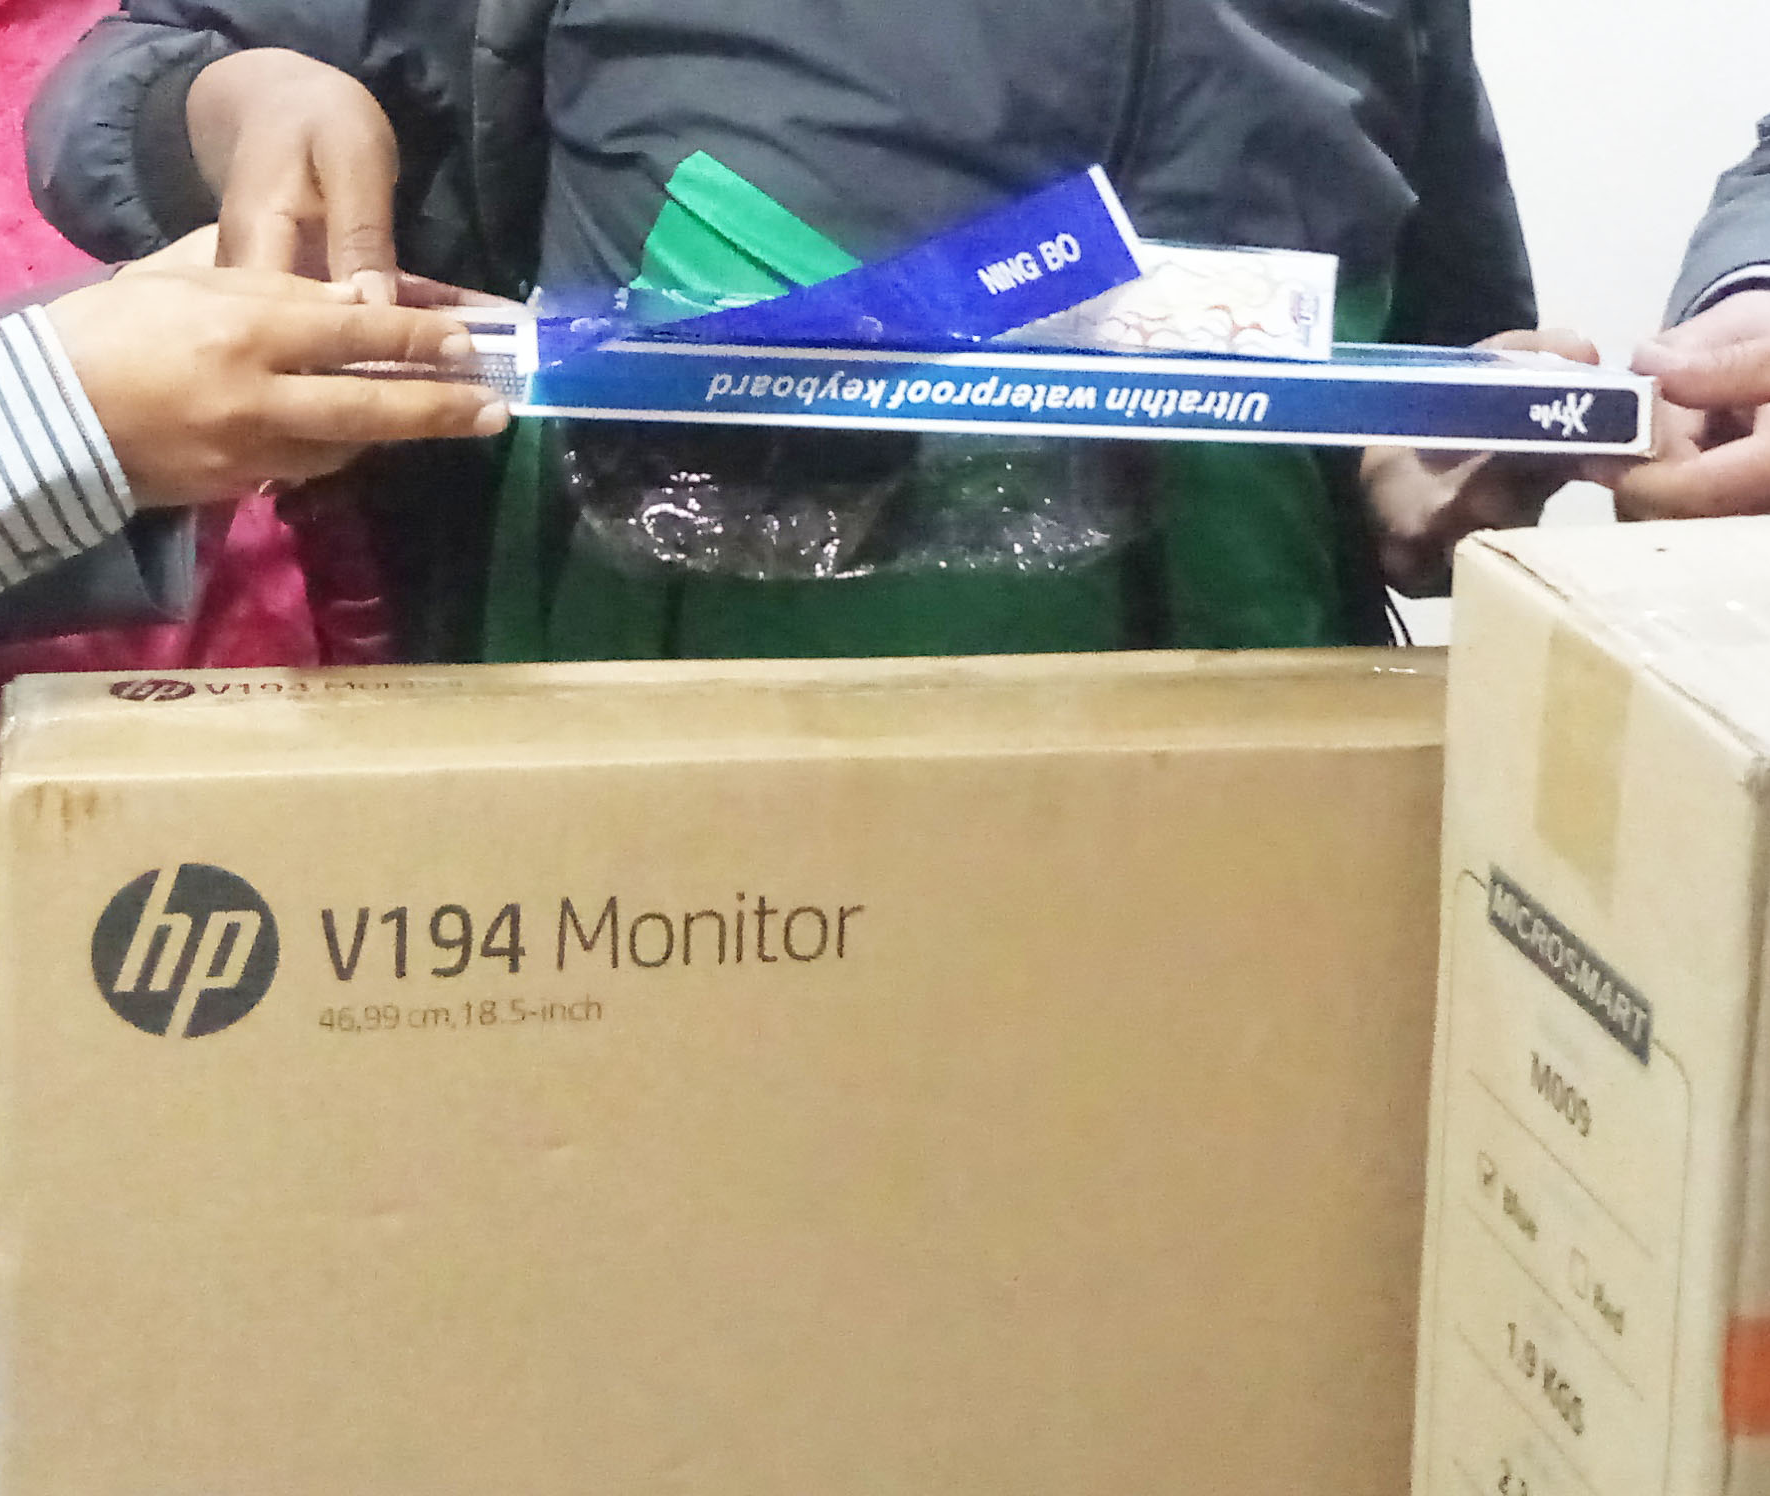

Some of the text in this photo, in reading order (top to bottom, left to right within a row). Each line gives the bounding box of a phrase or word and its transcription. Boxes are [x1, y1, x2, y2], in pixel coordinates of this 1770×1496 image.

[977, 232, 1083, 296] NING BO
[704, 370, 1270, 423] Ultrathin waterproof keyboard
[92, 862, 280, 1040] hp
[321, 890, 866, 981] V194 Monitor
[1490, 882, 1648, 1042] MICROSMART
